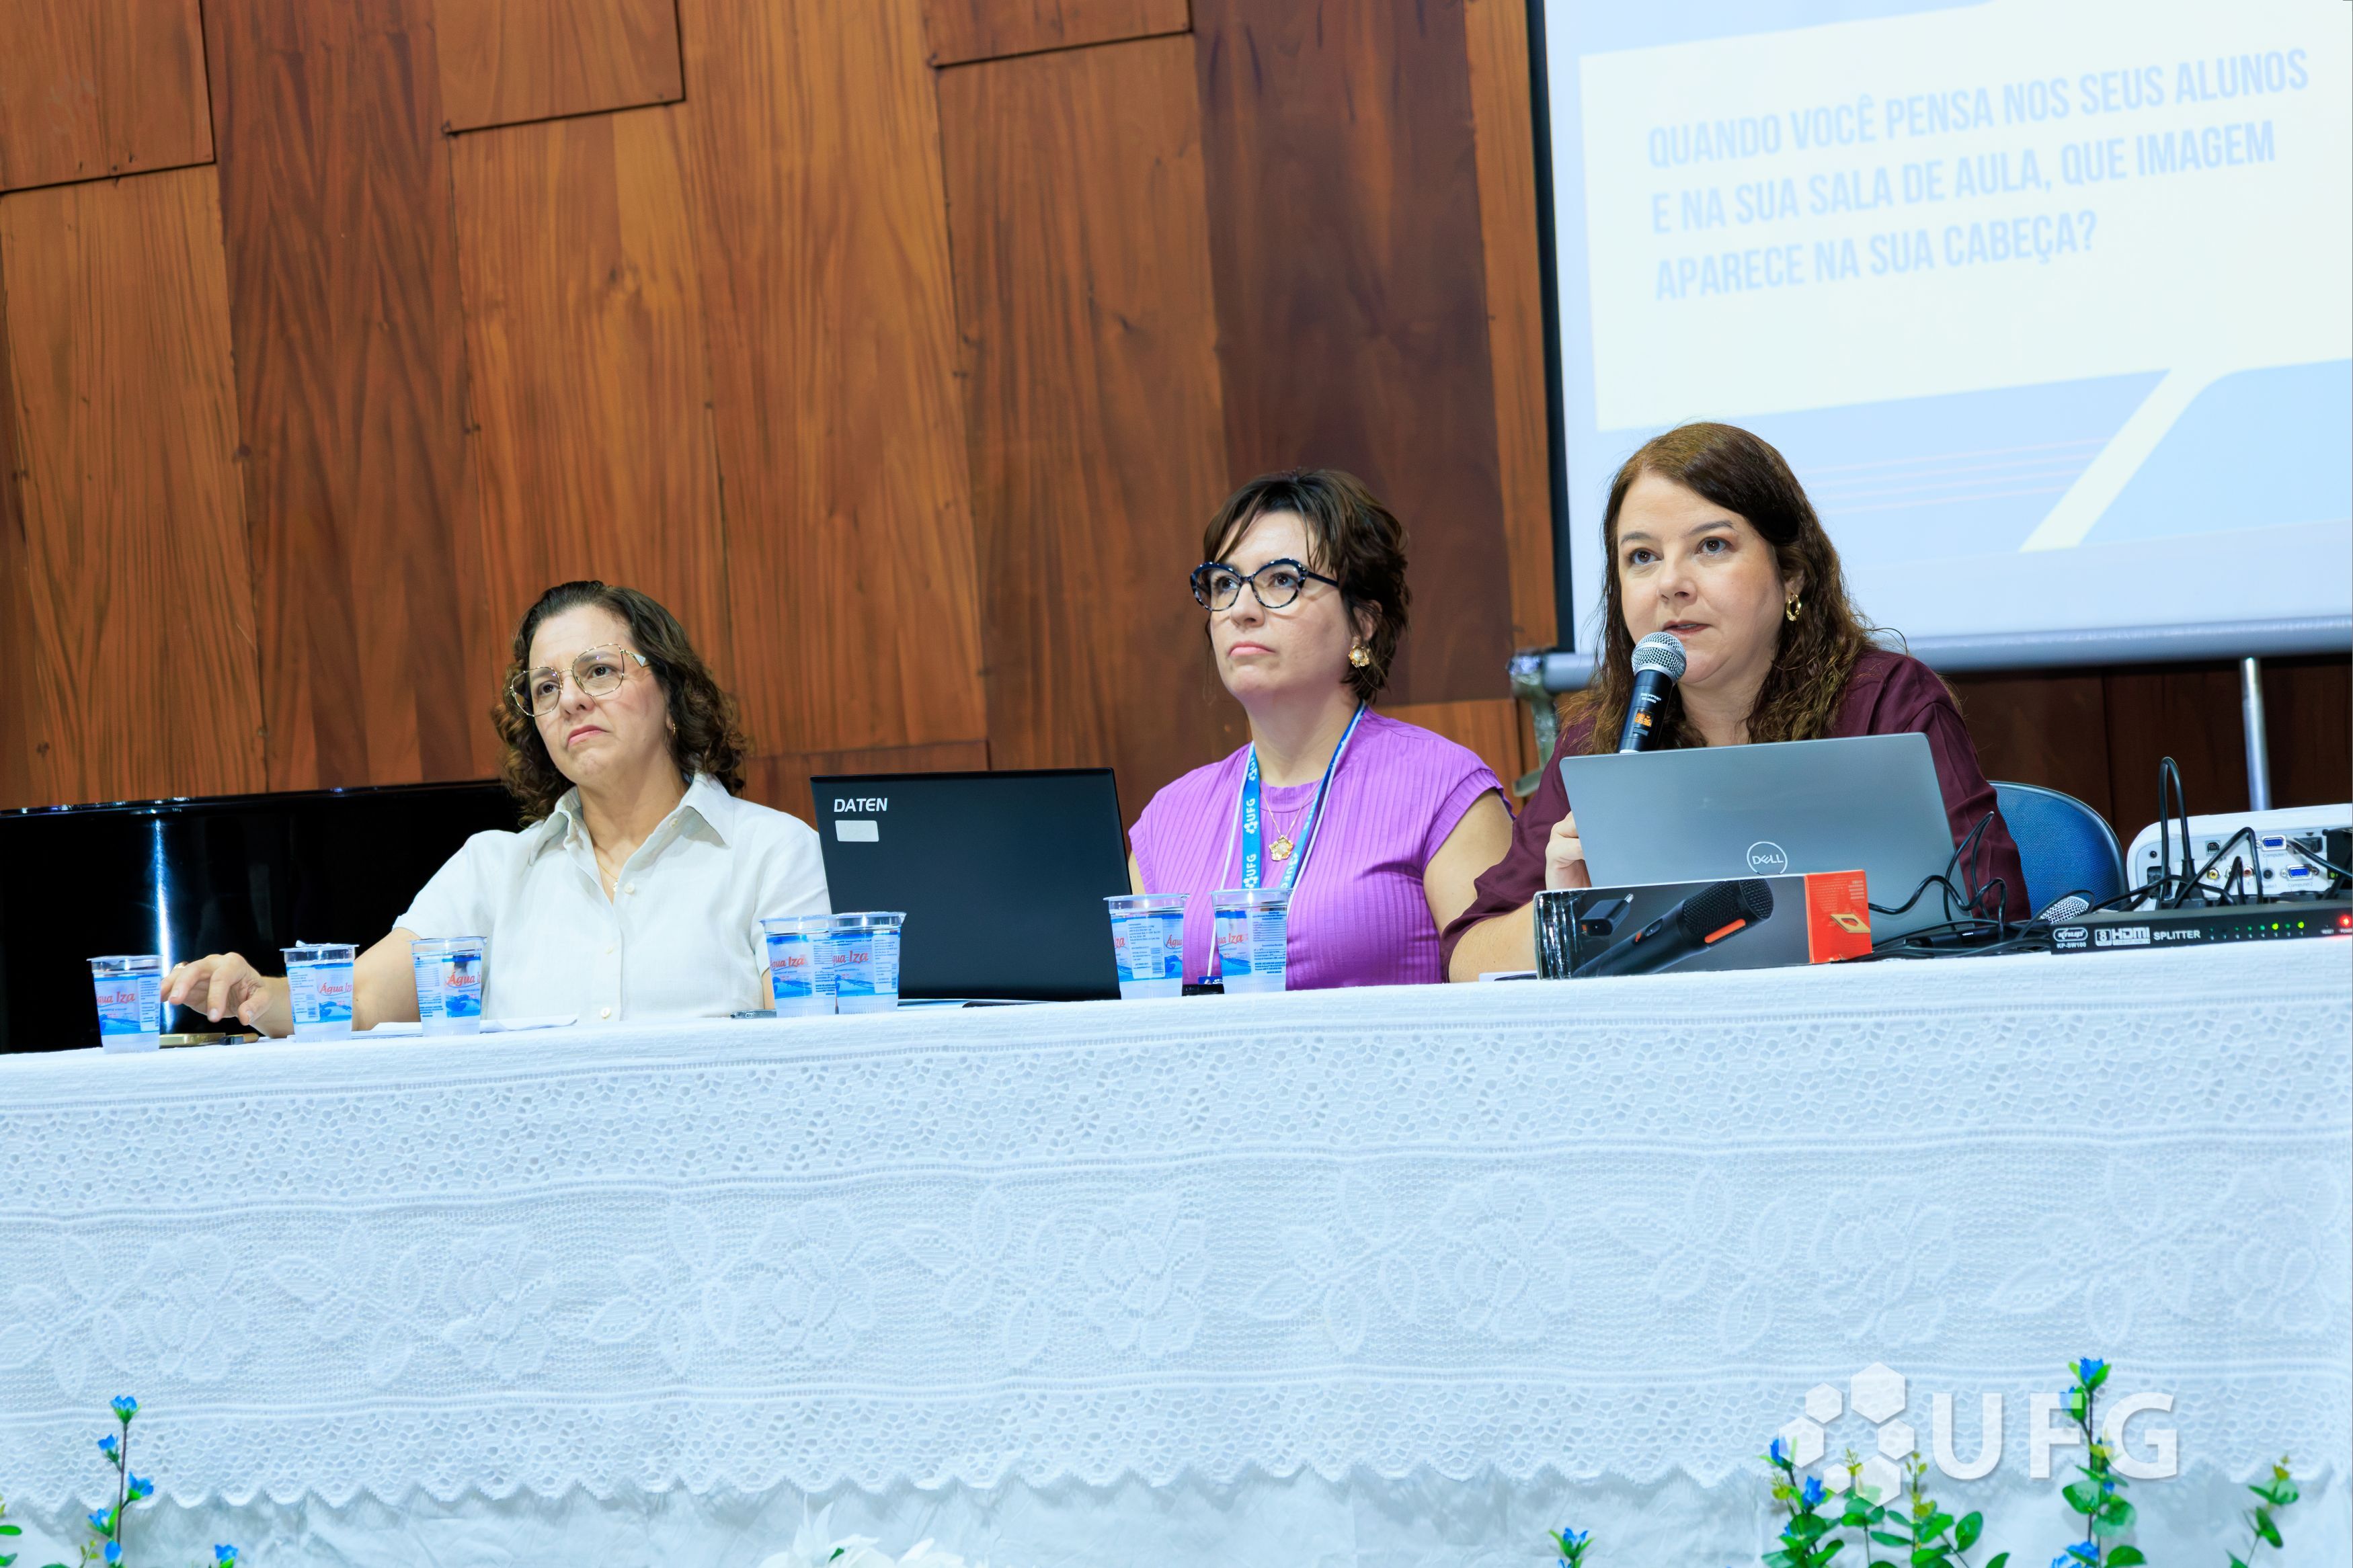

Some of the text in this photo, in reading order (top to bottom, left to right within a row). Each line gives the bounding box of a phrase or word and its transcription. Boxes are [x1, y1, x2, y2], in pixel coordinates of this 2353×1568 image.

[1648, 48, 2309, 169] QUANDO VOCÊ PENSA NOS SEUS ALUNOS
[1651, 120, 2275, 235] E NA SUA SALA DE AULA, QUE IMAGEM
[1655, 209, 2098, 301] APARECE NA SUA CABEÇA?
[834, 798, 887, 813] DATEN
[1246, 798, 1256, 822] UFG
[1246, 854, 1257, 877] UFG
[1752, 854, 1784, 865] DELL
[2112, 927, 2150, 940] HDMI
[2153, 930, 2200, 941] SPLITTER
[788, 956, 805, 968] Iza
[832, 954, 846, 966] gua
[849, 950, 869, 964] Iza
[445, 971, 475, 987] Água
[319, 982, 344, 995] Água
[96, 991, 135, 1007] gua Iza
